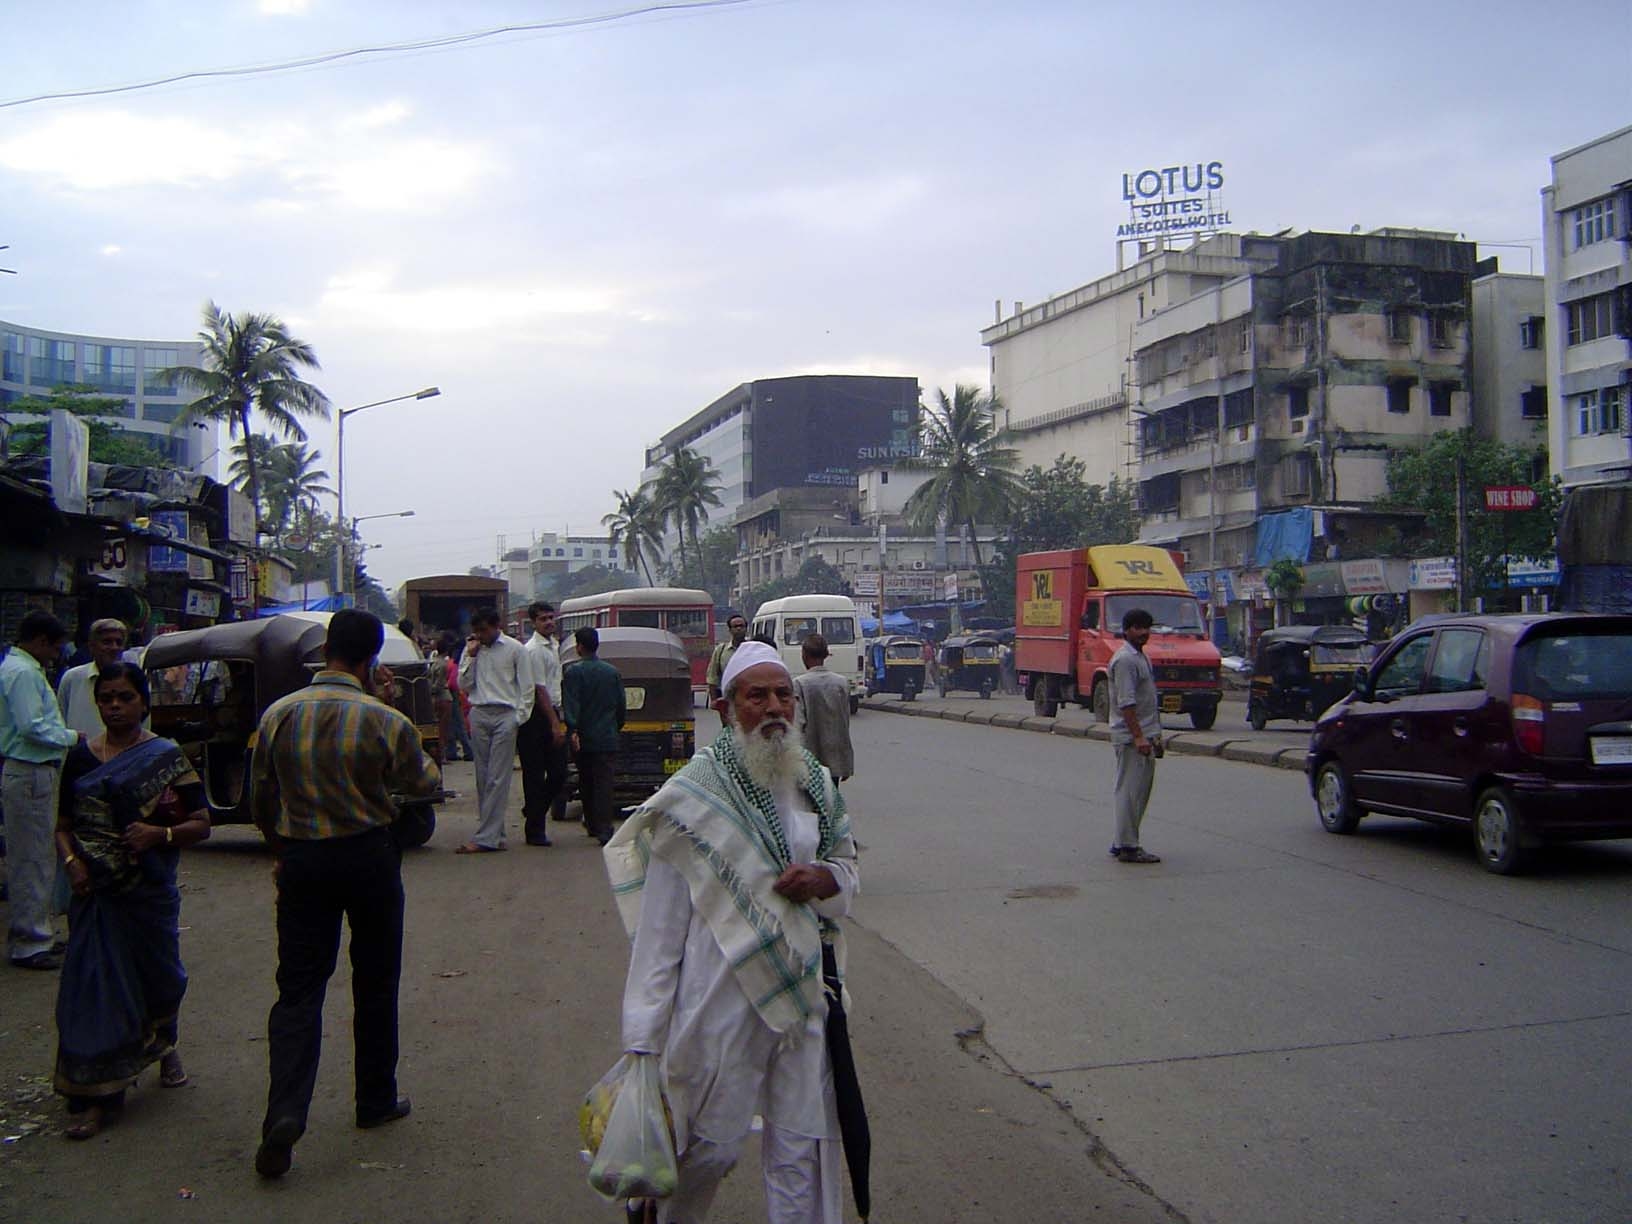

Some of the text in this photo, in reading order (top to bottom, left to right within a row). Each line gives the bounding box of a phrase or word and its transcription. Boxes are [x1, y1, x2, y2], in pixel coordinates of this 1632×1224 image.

[1122, 161, 1224, 200] LOTUS
[1141, 200, 1203, 218] SUITES
[1188, 211, 1232, 229] HOTEL
[1486, 490, 1535, 506] WINE SHOP
[1115, 561, 1163, 575] VRL
[1033, 573, 1051, 600] VRL
